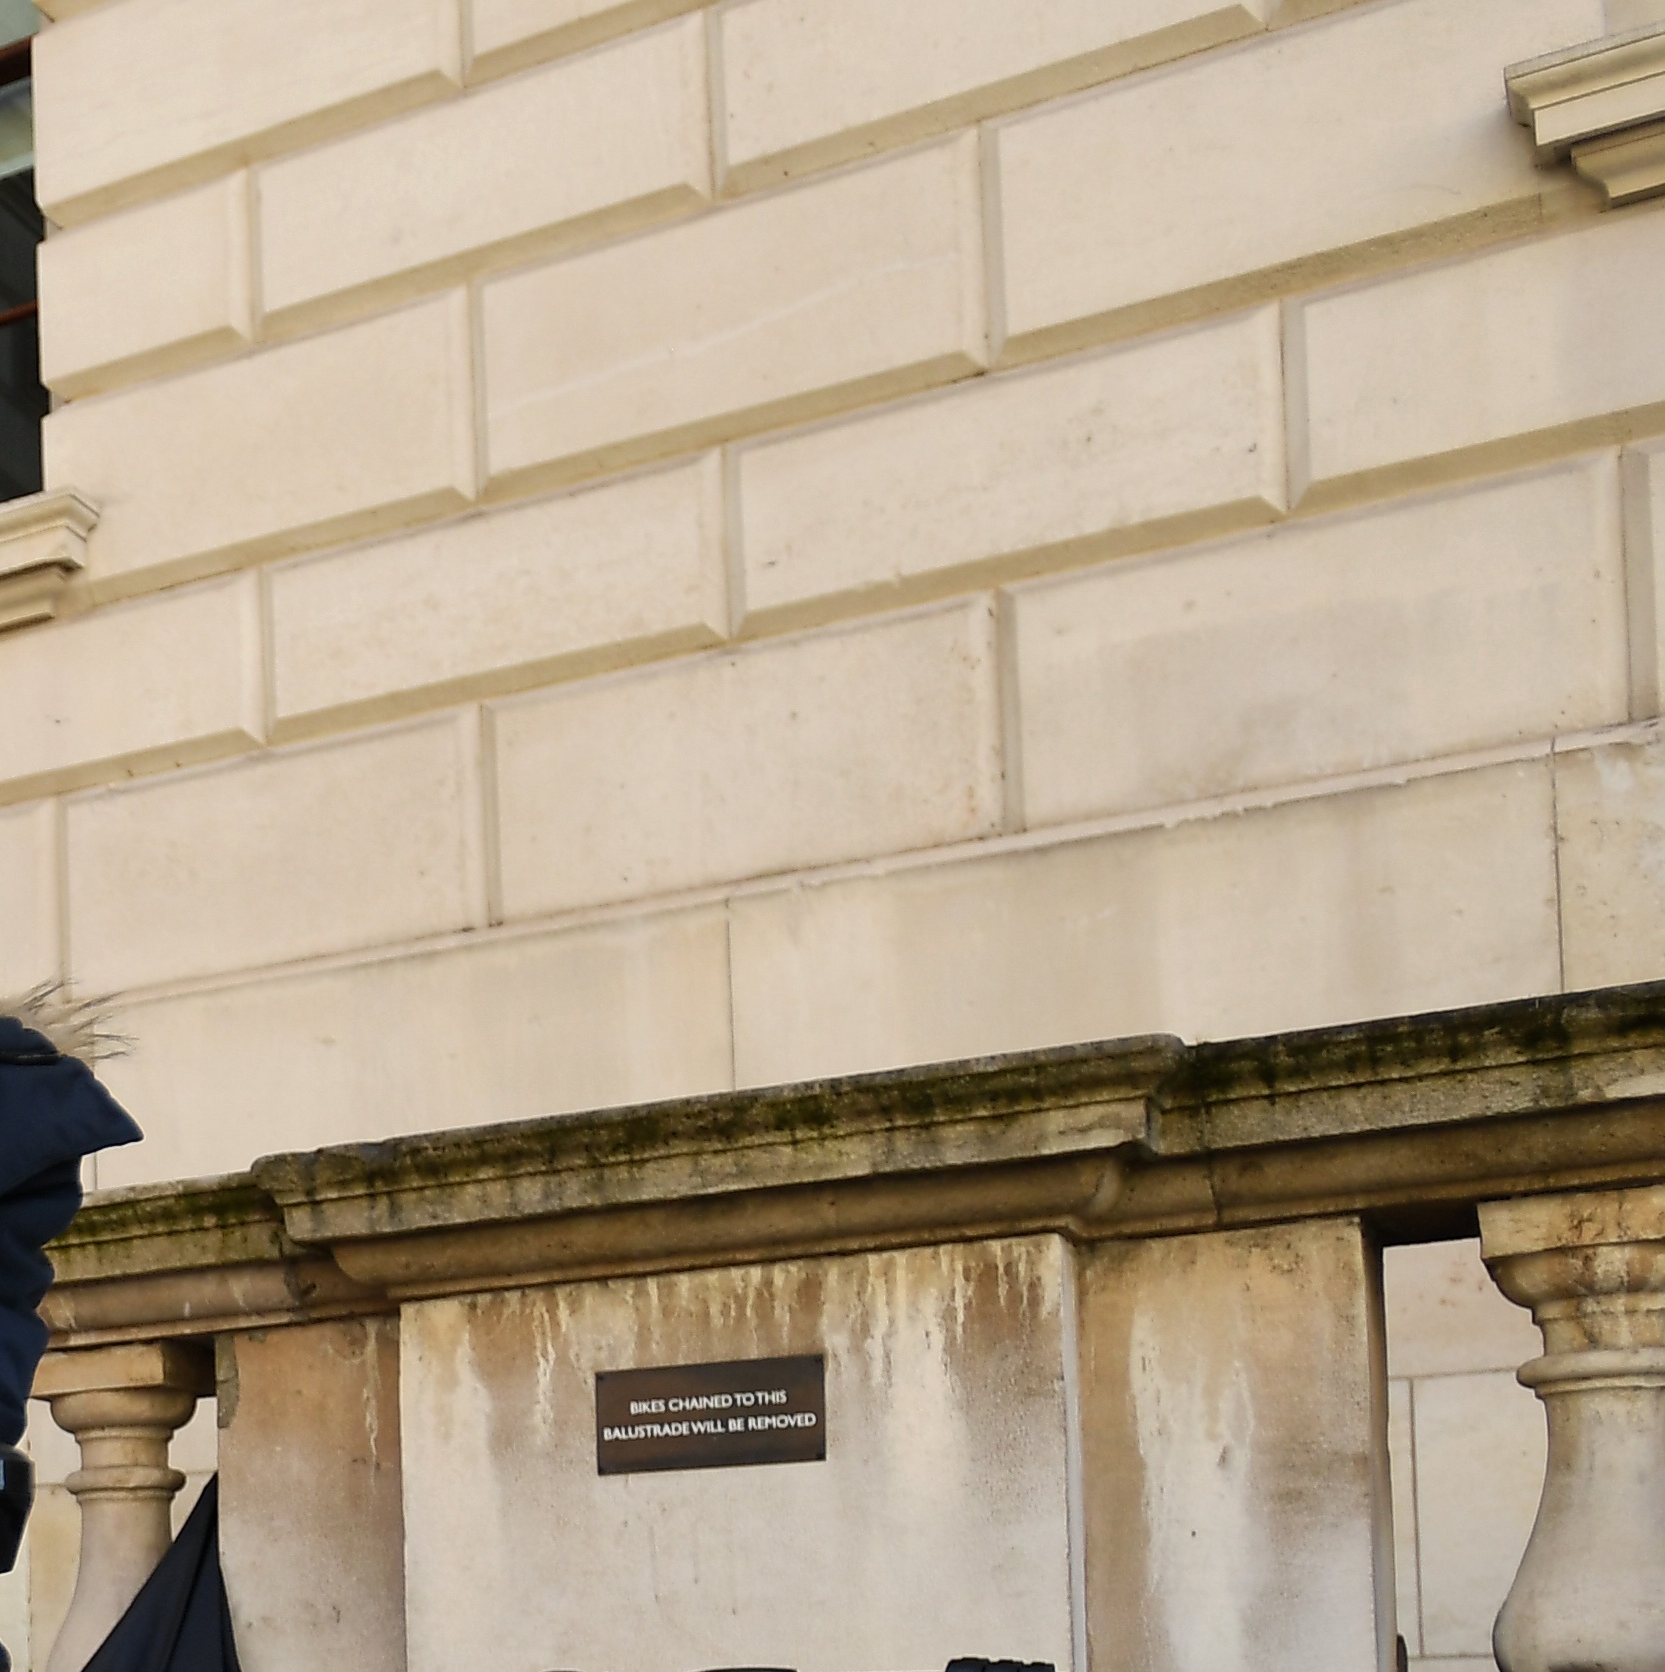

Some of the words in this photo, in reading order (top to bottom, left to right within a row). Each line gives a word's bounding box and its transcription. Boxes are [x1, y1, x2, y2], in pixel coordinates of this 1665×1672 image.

[629, 1399, 666, 1415] BIKES
[668, 1393, 732, 1412] CHAINED
[734, 1391, 755, 1407] TO
[755, 1388, 788, 1405] THIS
[603, 1421, 690, 1442] BALUSTRADE
[690, 1417, 726, 1435] WILL
[728, 1415, 745, 1431] BE
[748, 1411, 817, 1430] REMOVED
